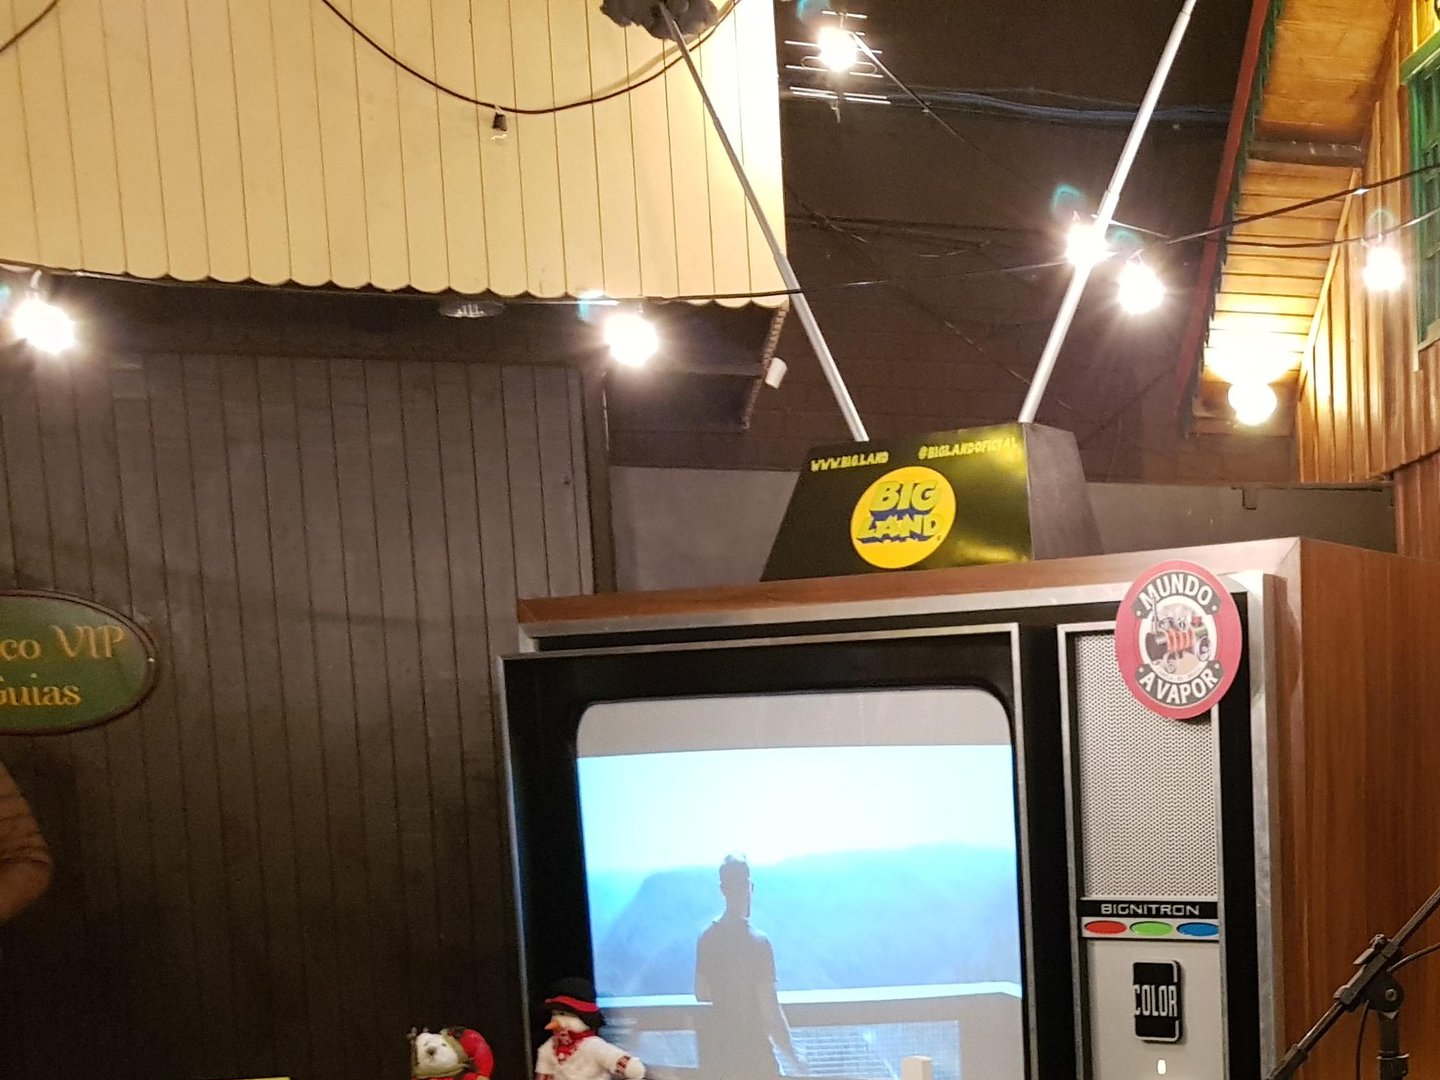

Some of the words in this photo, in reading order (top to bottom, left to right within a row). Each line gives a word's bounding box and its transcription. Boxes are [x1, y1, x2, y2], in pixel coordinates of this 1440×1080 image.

[869, 480, 939, 513] BIG
[856, 513, 943, 542] LAND
[1138, 573, 1213, 611] MUNDO
[51, 624, 125, 659] VIP
[1138, 671, 1156, 691] A
[1156, 668, 1218, 704] VAPOR
[1100, 903, 1200, 916] BIGNITRON
[1133, 984, 1178, 1018] COLOR
